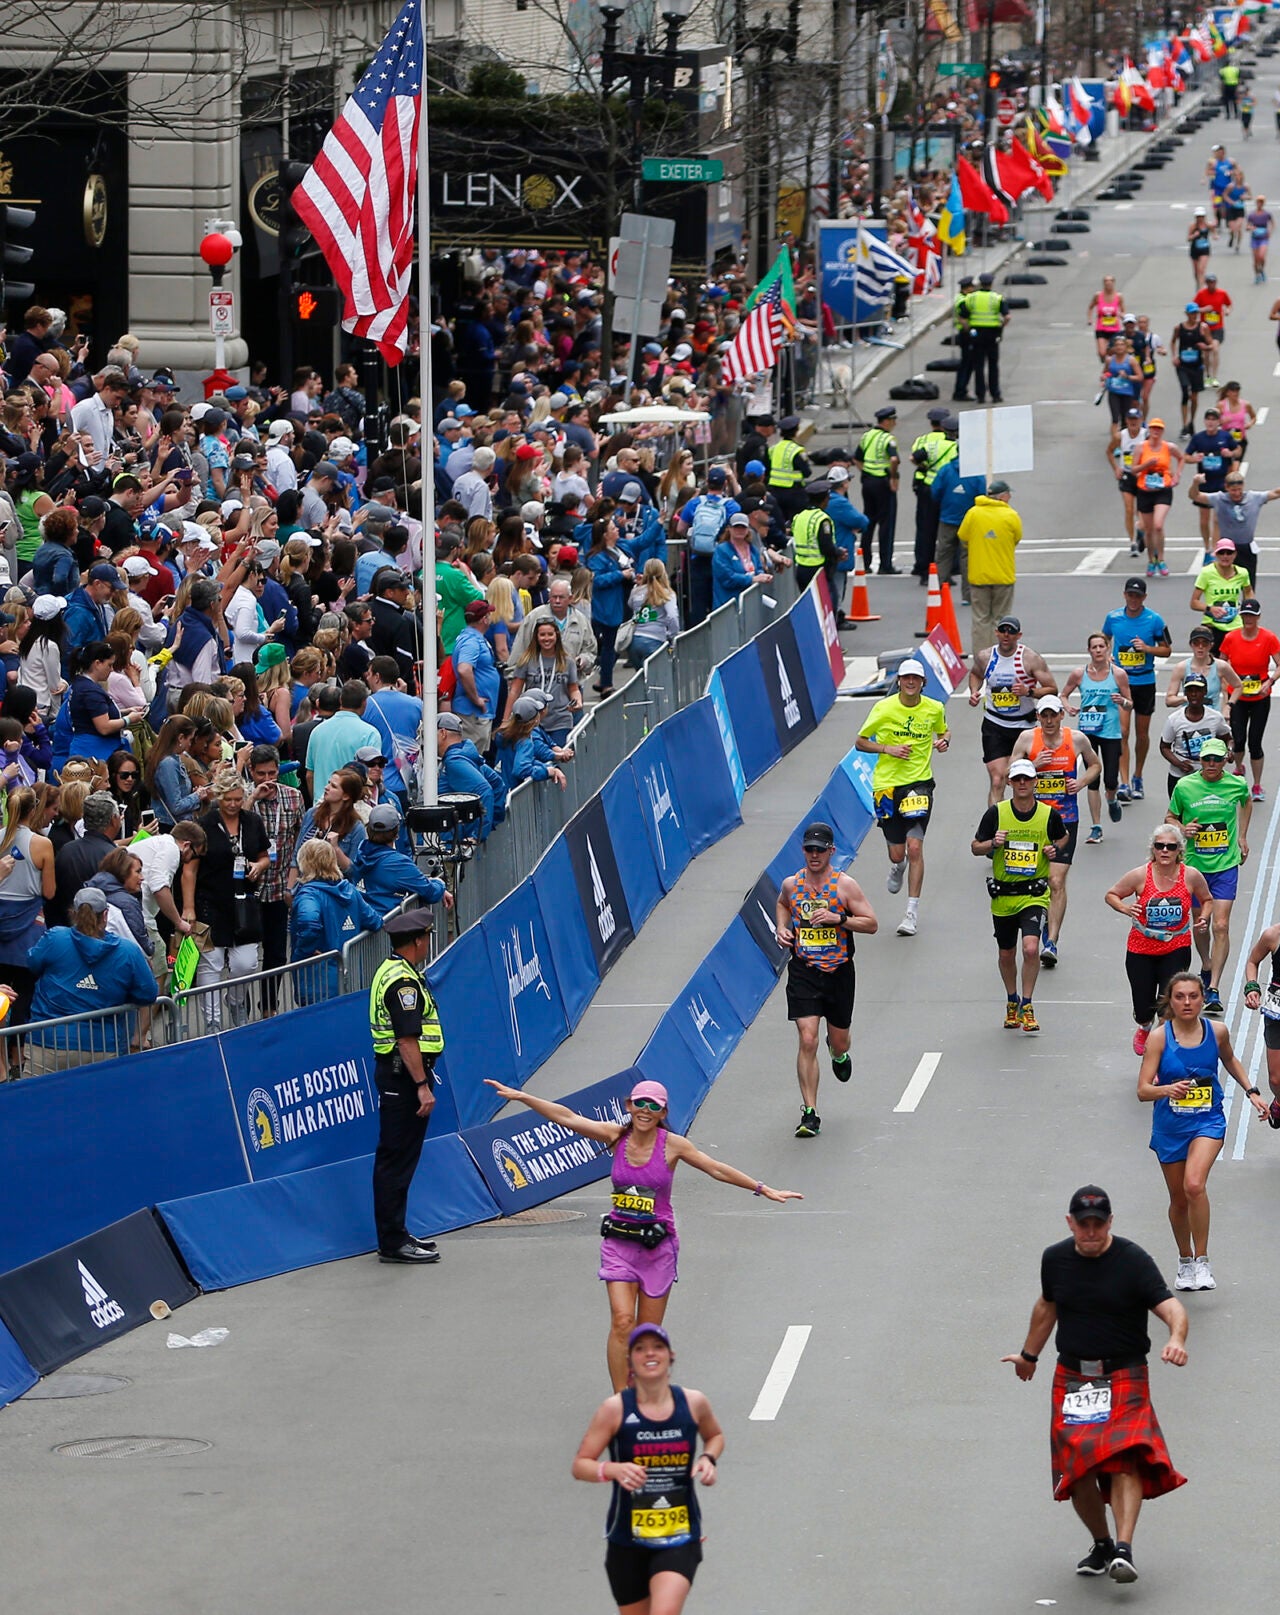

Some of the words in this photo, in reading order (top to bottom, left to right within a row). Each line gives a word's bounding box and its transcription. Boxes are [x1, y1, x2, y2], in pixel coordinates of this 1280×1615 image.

[660, 164, 703, 180] EXETER
[1196, 832, 1228, 843] 24175
[1005, 851, 1037, 863] 28561
[1147, 906, 1182, 919] 23090
[801, 929, 836, 940] 26186
[274, 1077, 301, 1108] THE
[303, 1059, 359, 1098] BOSTON
[281, 1089, 365, 1142] MARATHON
[511, 1130, 539, 1156] THE
[533, 1121, 577, 1148] BOSTO
[526, 1136, 597, 1182] MARATHON
[91, 1299, 125, 1328] adidas
[1065, 1390, 1110, 1409] 12173
[636, 1429, 683, 1441] COLLEEN
[633, 1454, 690, 1467] STRONG
[634, 1511, 687, 1527] 26398
